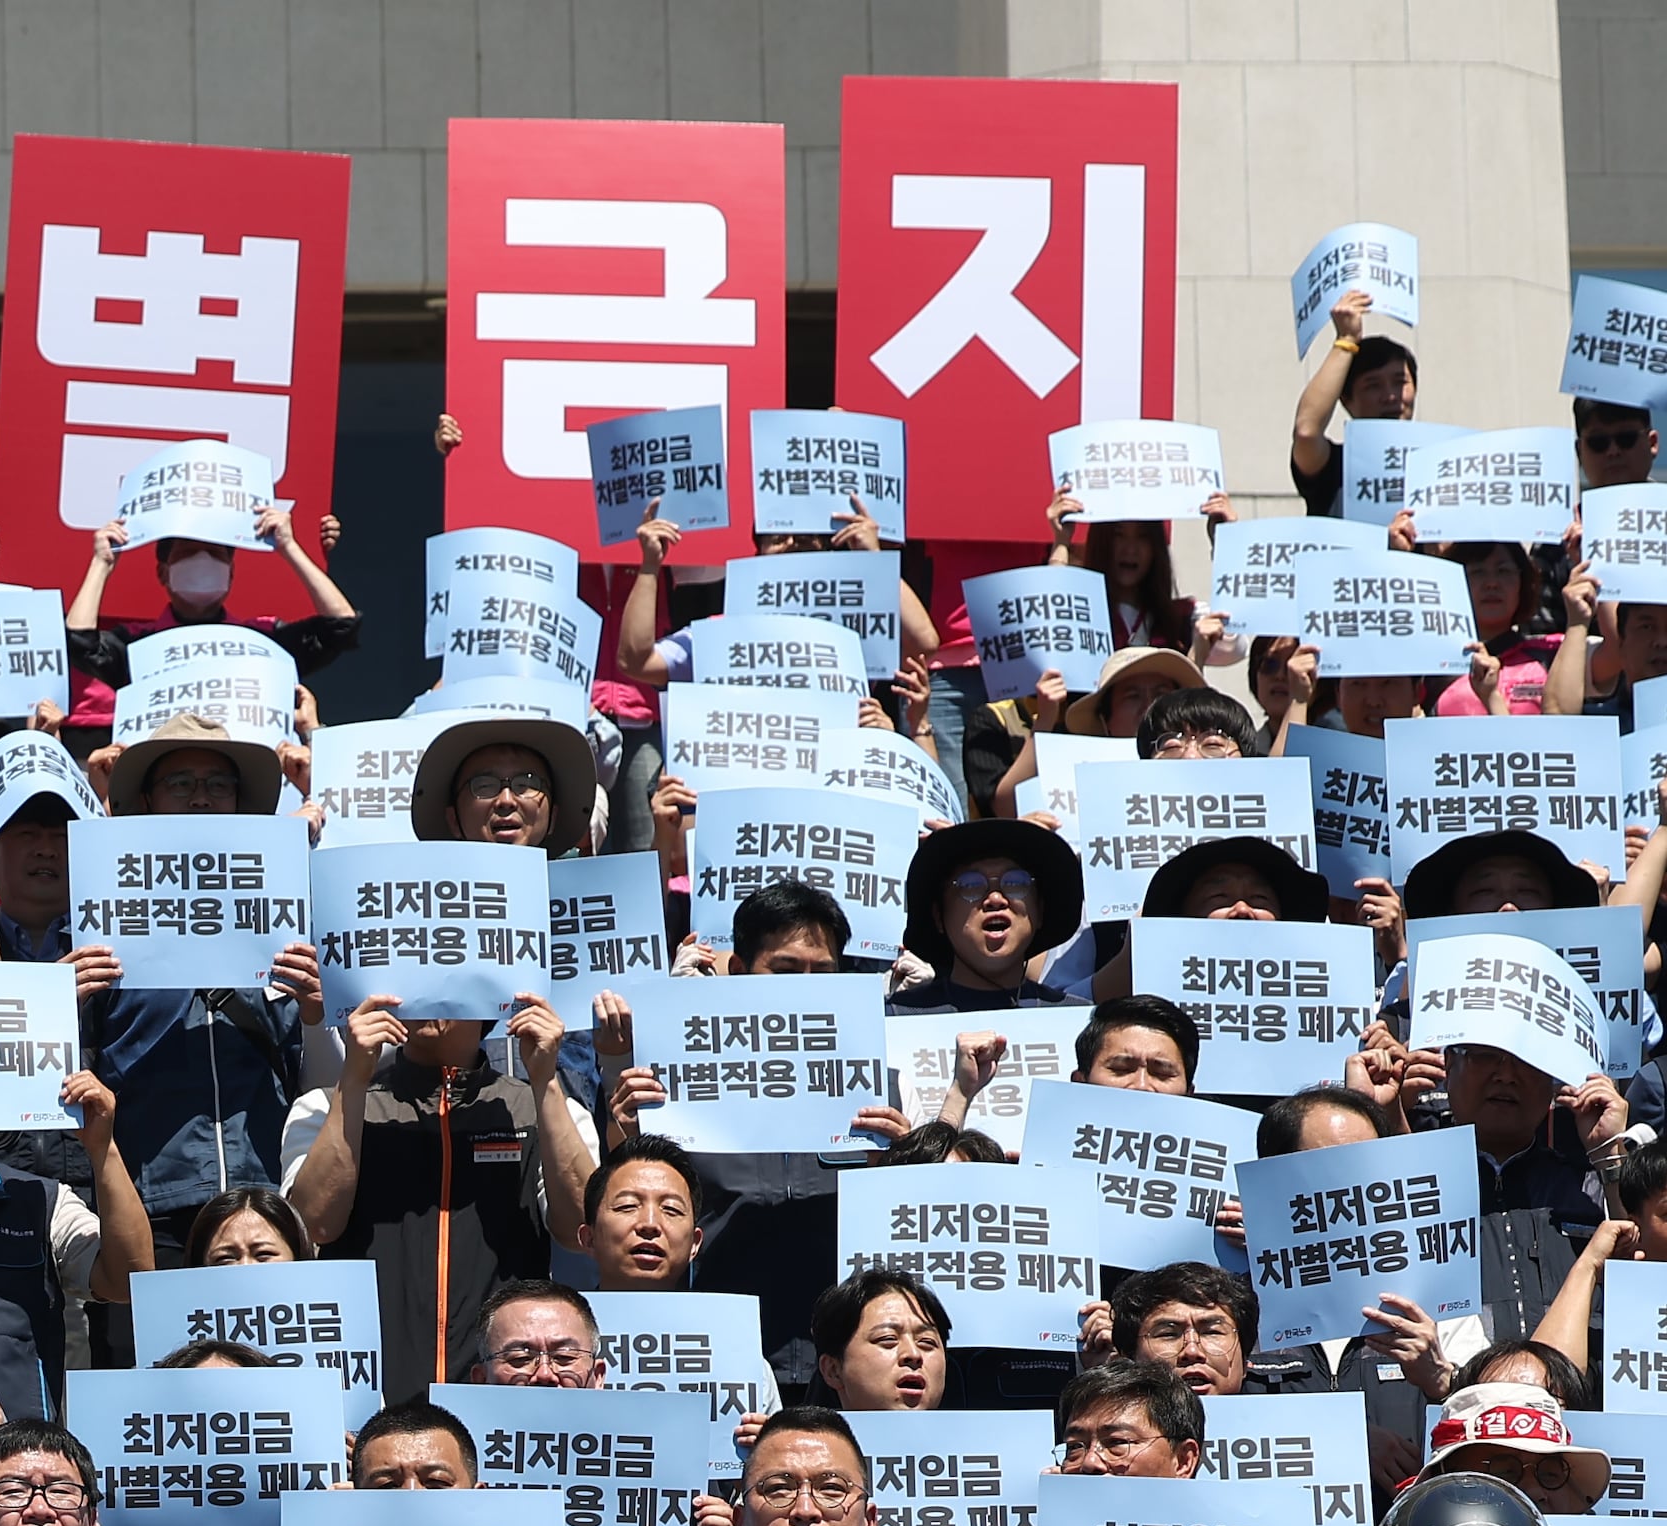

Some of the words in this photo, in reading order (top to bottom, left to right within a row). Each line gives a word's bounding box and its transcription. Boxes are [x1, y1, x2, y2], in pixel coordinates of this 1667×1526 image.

[869, 163, 1145, 420] 지
[476, 196, 755, 478] 금
[36, 225, 300, 530] 별
[787, 437, 880, 469] 최저임금
[1438, 453, 1542, 479] 최저임금
[759, 468, 859, 497] 차별적용
[864, 473, 901, 504] 폐지
[1409, 481, 1513, 507] 차별적용
[1520, 482, 1570, 509] 폐지
[998, 594, 1091, 625] 최저임금
[1334, 578, 1441, 604] 최저임금
[1304, 609, 1414, 637] 차별적용
[1421, 610, 1473, 639] 폐지
[979, 625, 1074, 662] 차별적용
[1078, 628, 1111, 657] 폐지
[8, 649, 63, 677] 폐지
[1435, 752, 1576, 788] 최저임금
[1396, 795, 1539, 833] 차별적용
[1548, 795, 1617, 831] 폐지
[117, 853, 265, 890] 최저임금
[78, 898, 224, 936] 차별적용
[234, 897, 305, 935] 폐지
[357, 881, 507, 919] 최저임금
[321, 927, 467, 970] 차별적용
[477, 928, 546, 969] 폐지
[684, 1014, 837, 1054] 최저임금
[652, 1060, 796, 1102] 차별적용
[806, 1059, 882, 1097] 폐지
[1289, 1174, 1441, 1236] 최저임금
[1256, 1230, 1409, 1289] 차별적용
[1416, 1217, 1476, 1264] 폐지
